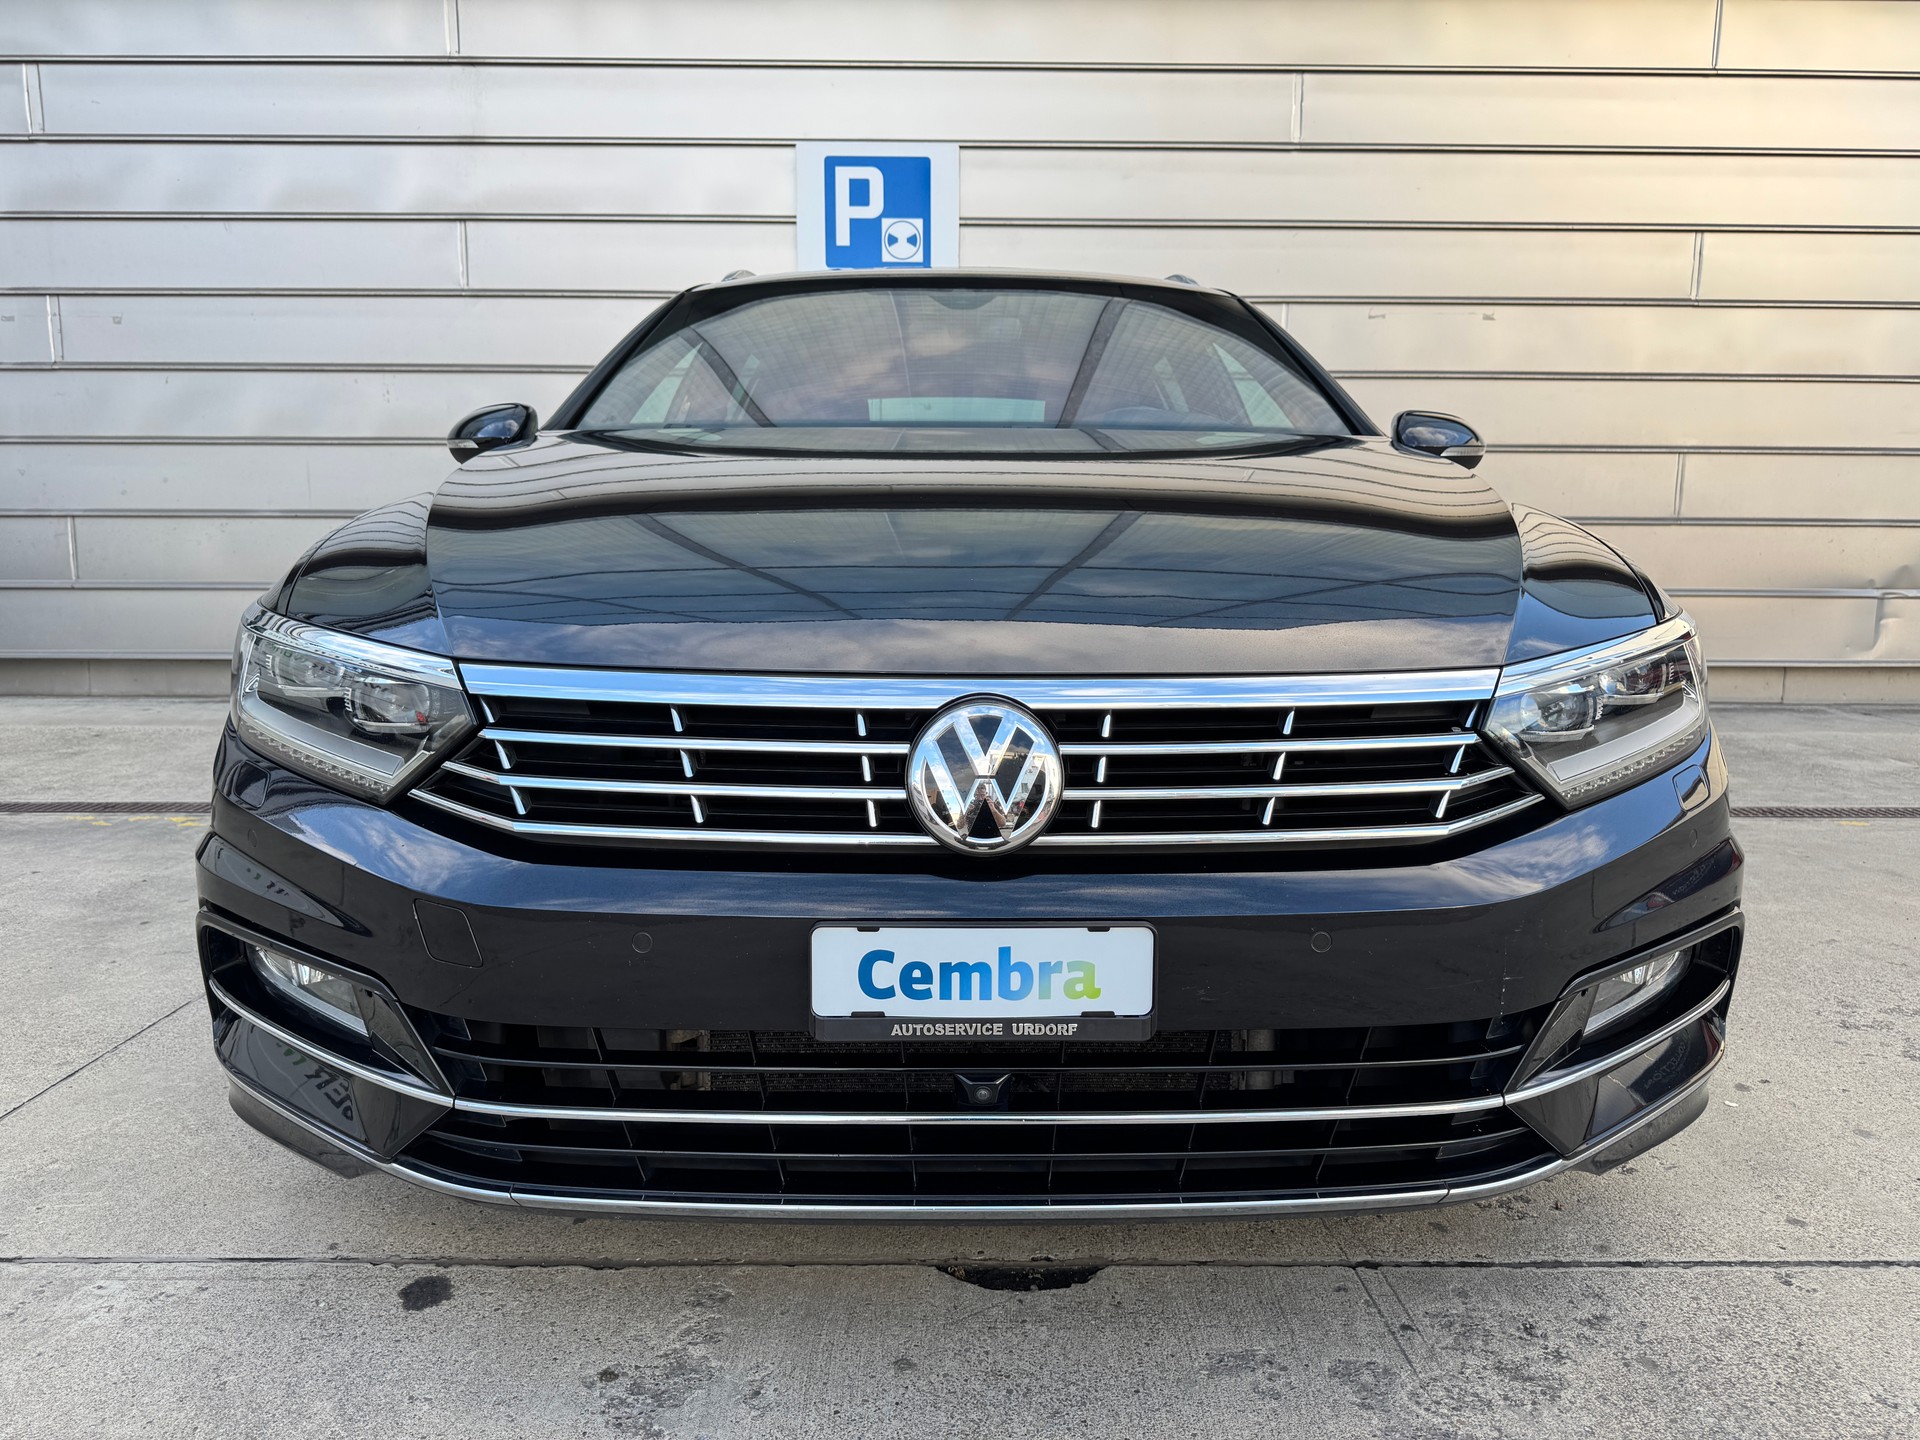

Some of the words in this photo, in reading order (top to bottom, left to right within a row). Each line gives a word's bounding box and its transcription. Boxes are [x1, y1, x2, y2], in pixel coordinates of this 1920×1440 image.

[835, 166, 884, 246] P
[858, 946, 1101, 1001] Cembra
[891, 1023, 1003, 1036] AUTOSERVICE
[1012, 1023, 1078, 1036] URDORF
